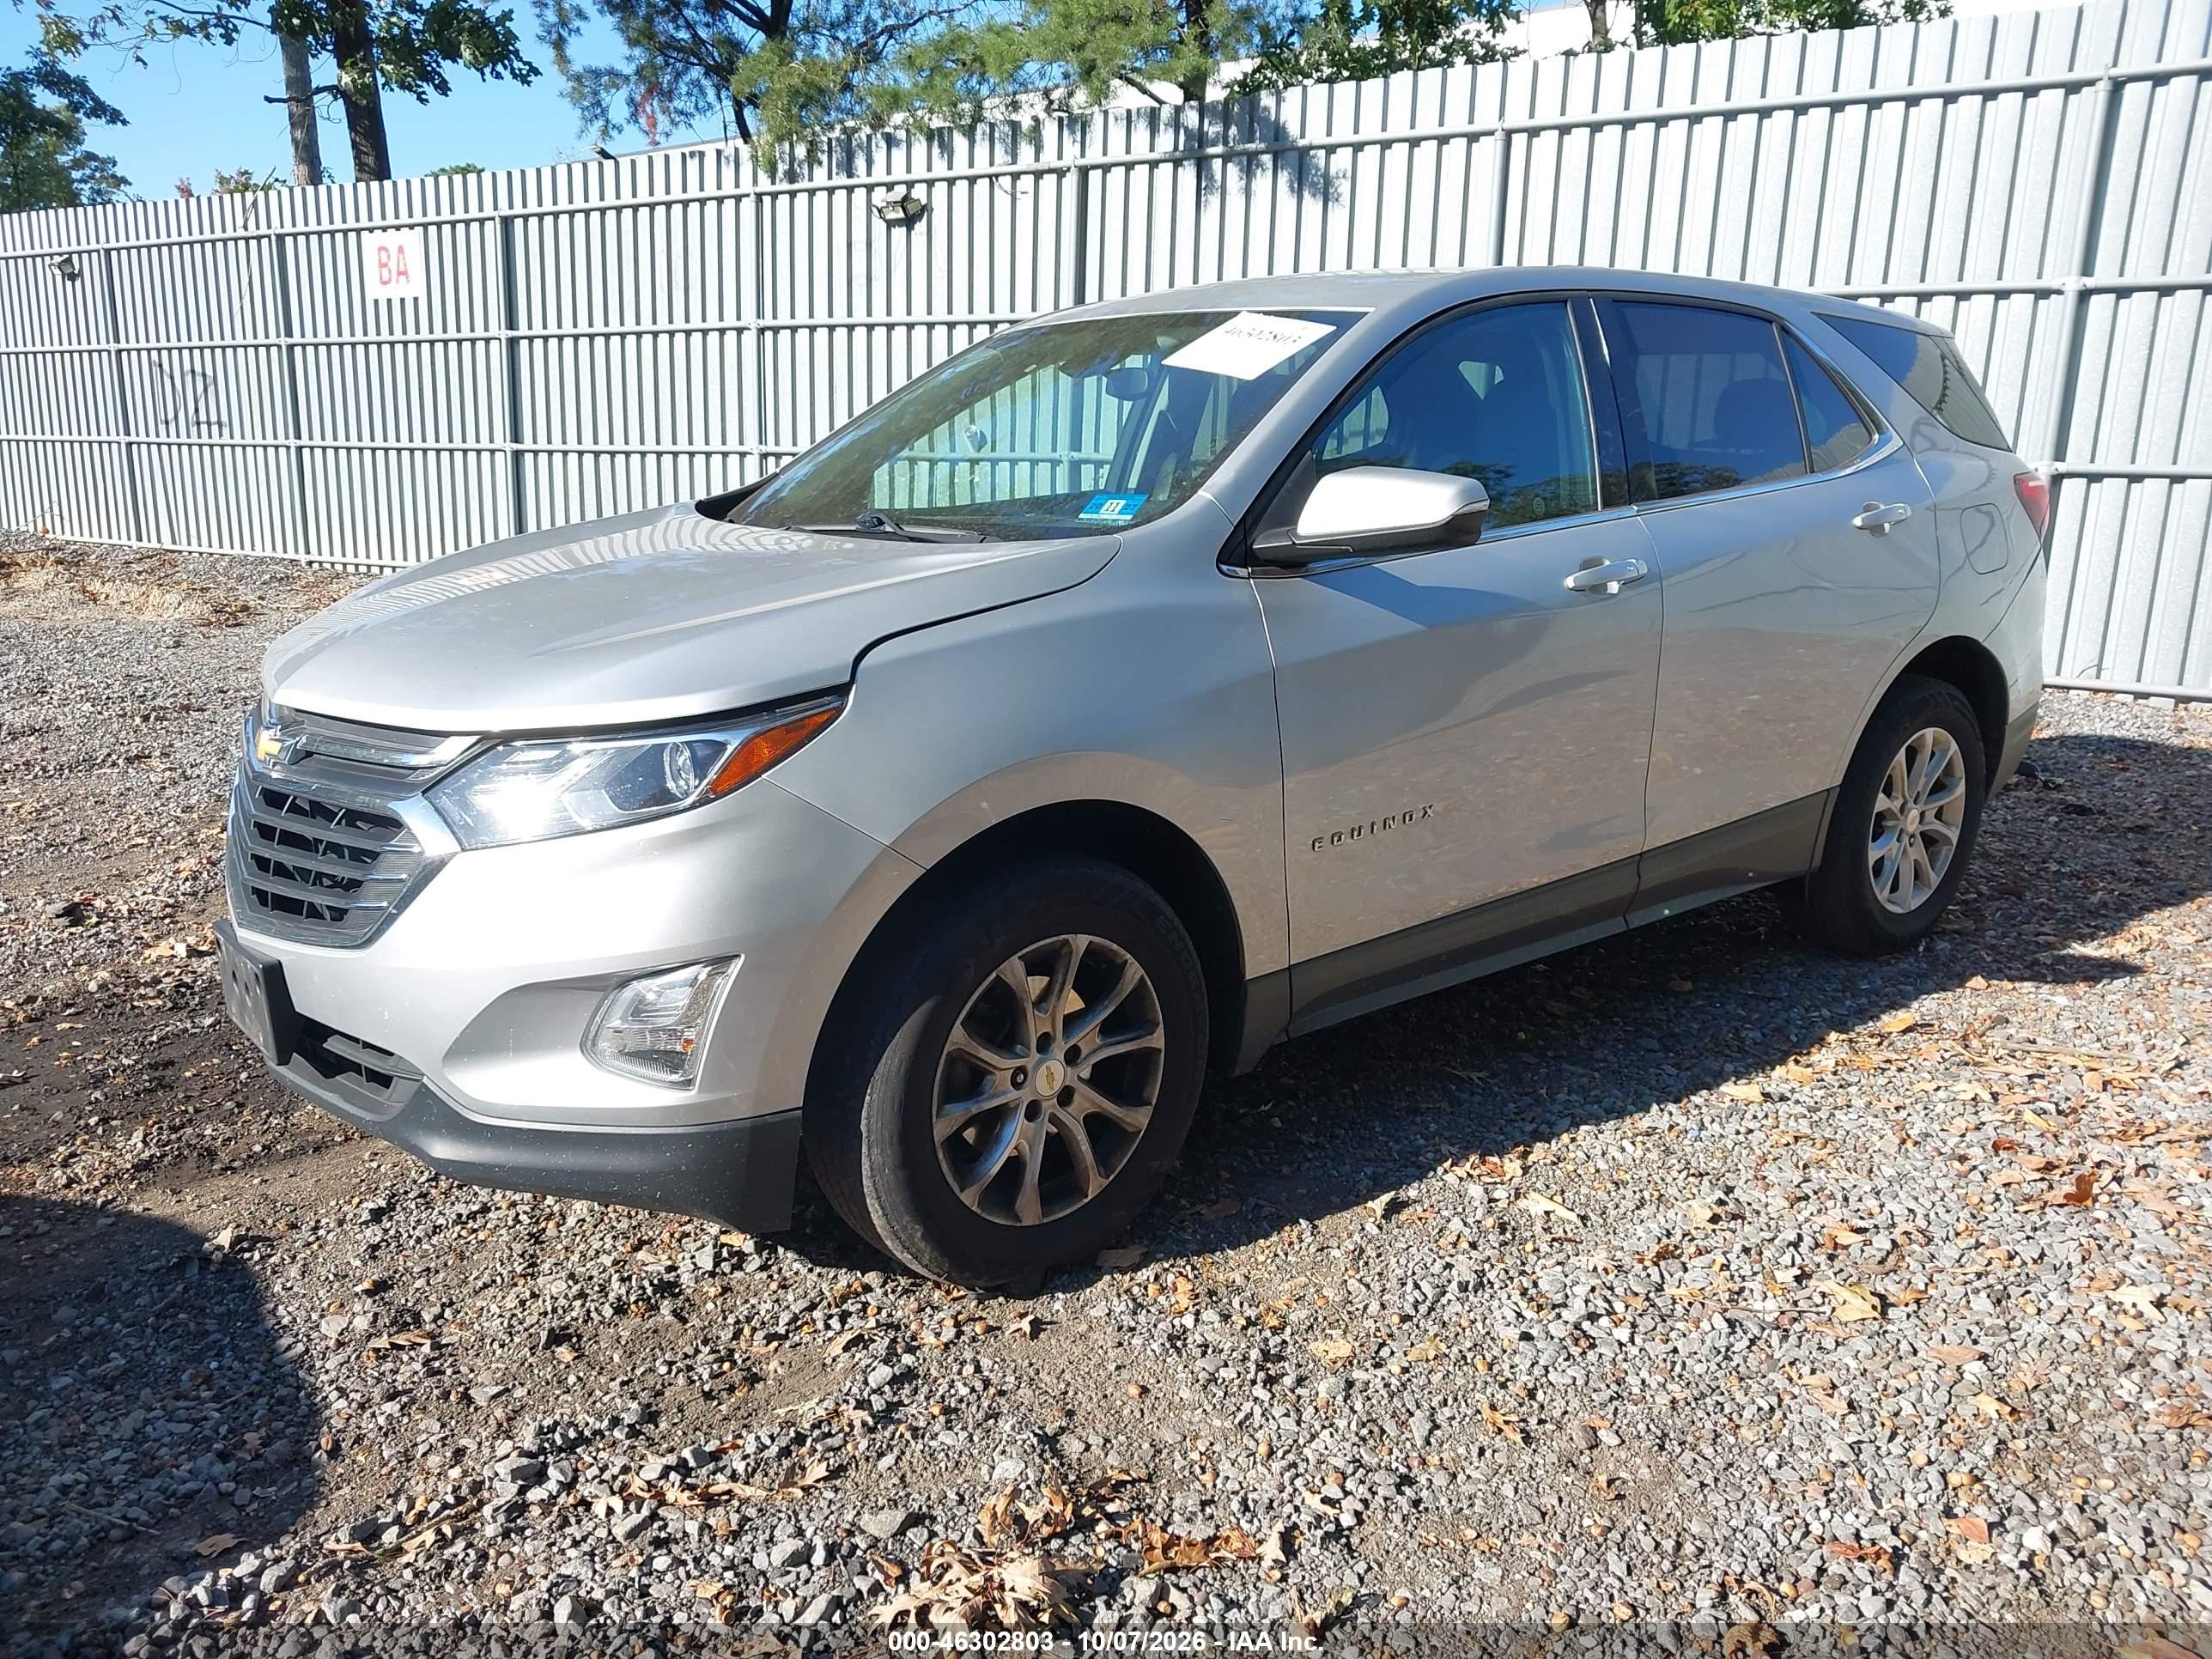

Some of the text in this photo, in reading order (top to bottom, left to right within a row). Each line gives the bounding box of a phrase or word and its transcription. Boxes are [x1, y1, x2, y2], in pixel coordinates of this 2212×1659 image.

[376, 244, 410, 286] BA
[1103, 501, 1121, 513] 11
[1311, 803, 1435, 852] EQUINOX
